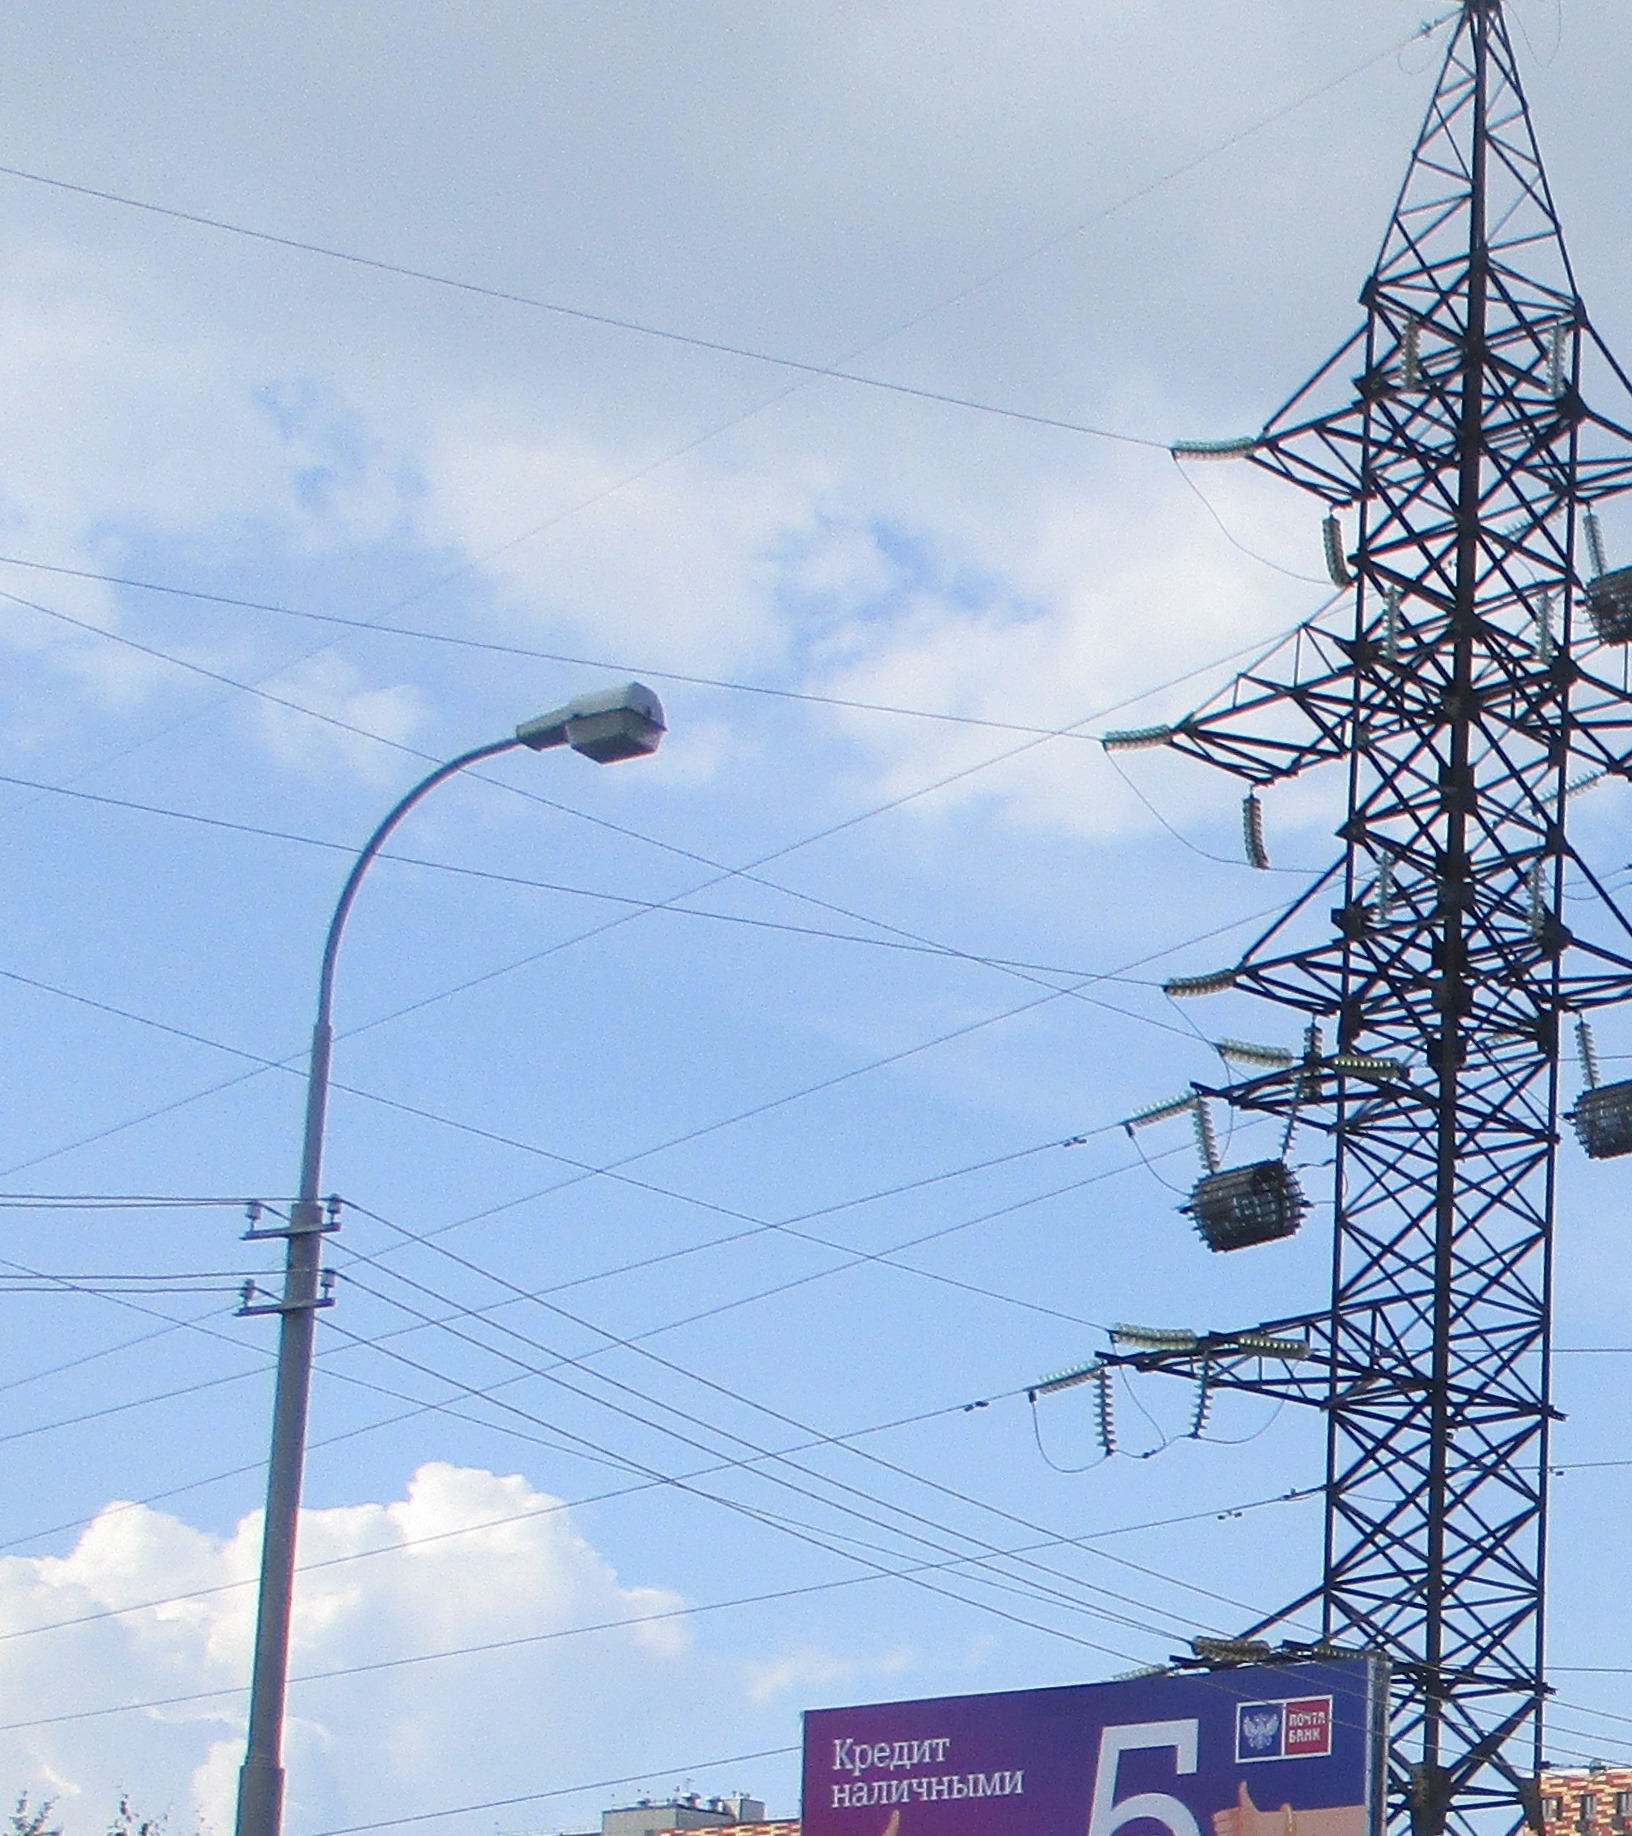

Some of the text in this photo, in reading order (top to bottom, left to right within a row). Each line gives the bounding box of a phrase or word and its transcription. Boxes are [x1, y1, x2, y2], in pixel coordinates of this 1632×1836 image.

[1288, 1728, 1321, 1743] БАНК
[832, 1737, 950, 1776] Кредит
[831, 1769, 1025, 1808] наличными
